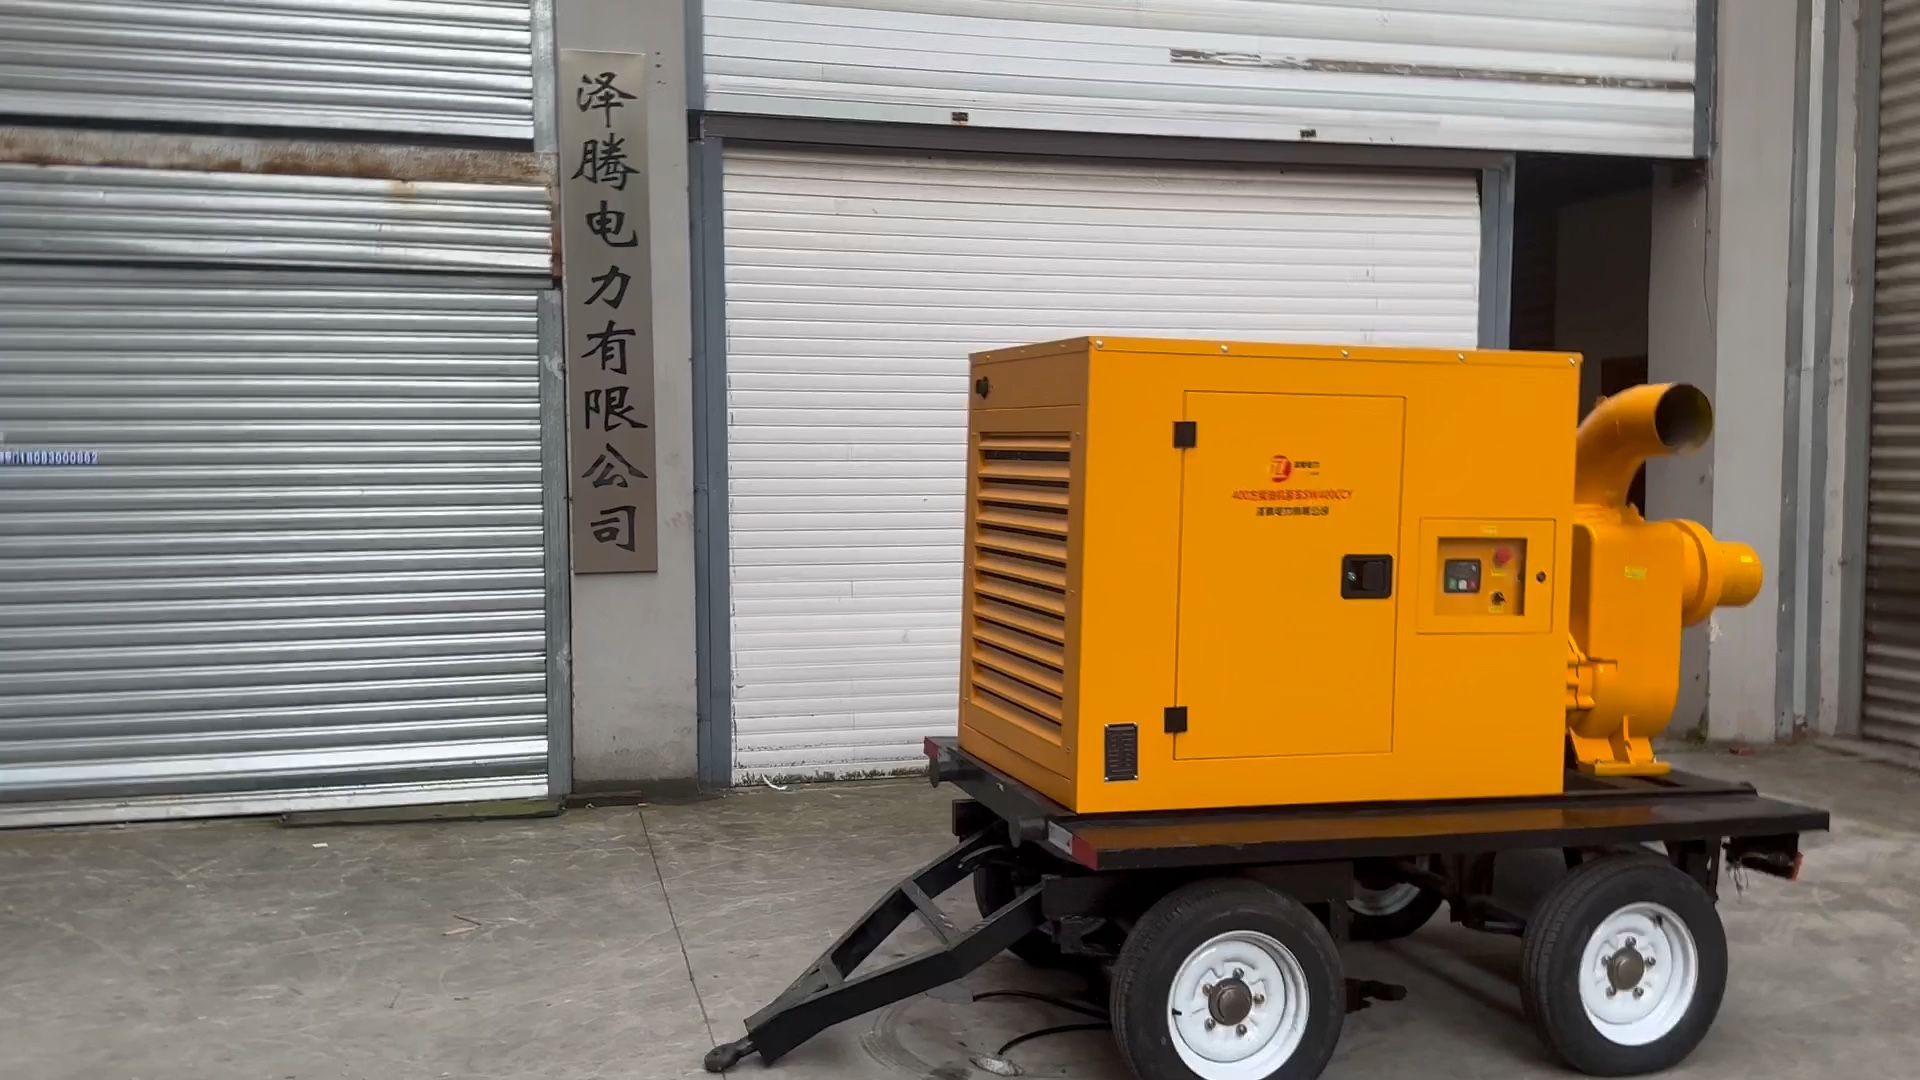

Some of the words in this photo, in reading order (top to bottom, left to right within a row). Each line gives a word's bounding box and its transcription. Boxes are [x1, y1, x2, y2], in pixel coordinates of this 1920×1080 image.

[571, 72, 648, 553] 泽腾电力有限公司
